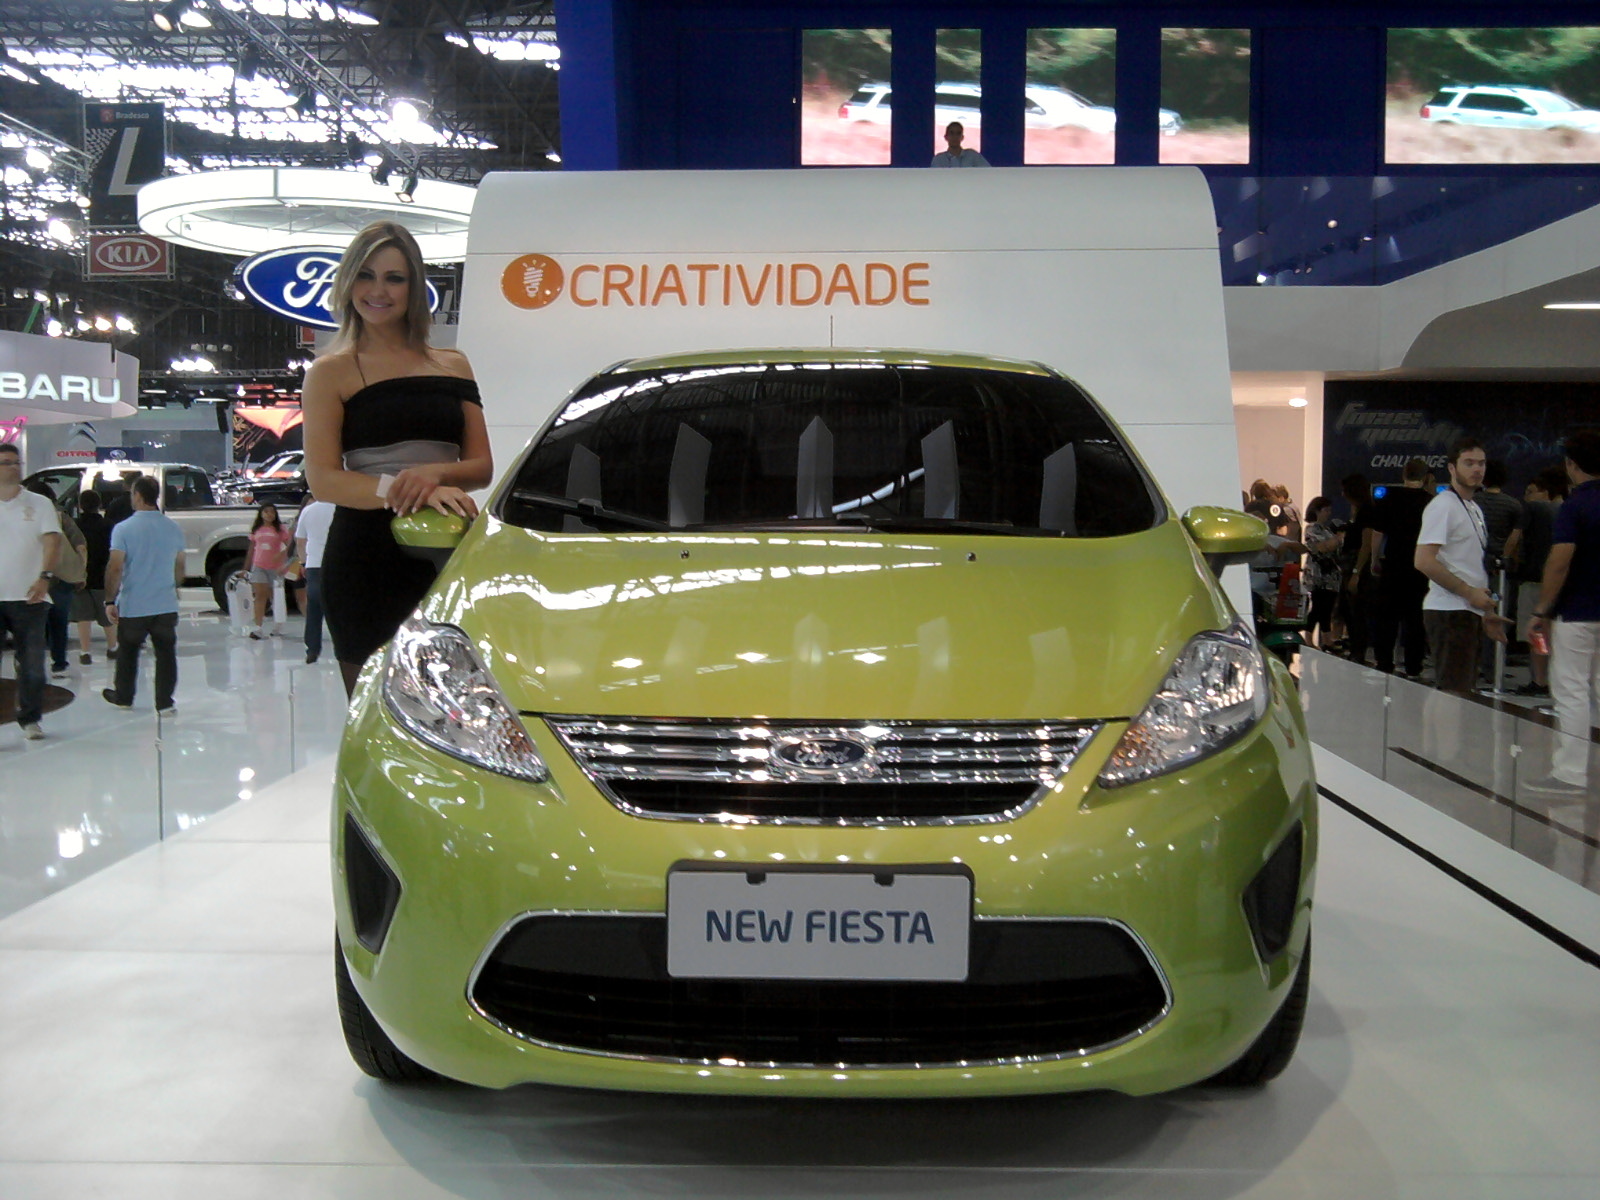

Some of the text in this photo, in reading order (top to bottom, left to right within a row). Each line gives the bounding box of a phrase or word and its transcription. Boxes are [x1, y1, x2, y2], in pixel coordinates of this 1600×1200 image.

[115, 111, 150, 119] Bradesco
[107, 245, 151, 263] KIA
[569, 262, 931, 307] CRIATIVIDADE
[1370, 454, 1448, 468] CHALLNGE
[706, 909, 934, 944] NEW FIESTA
